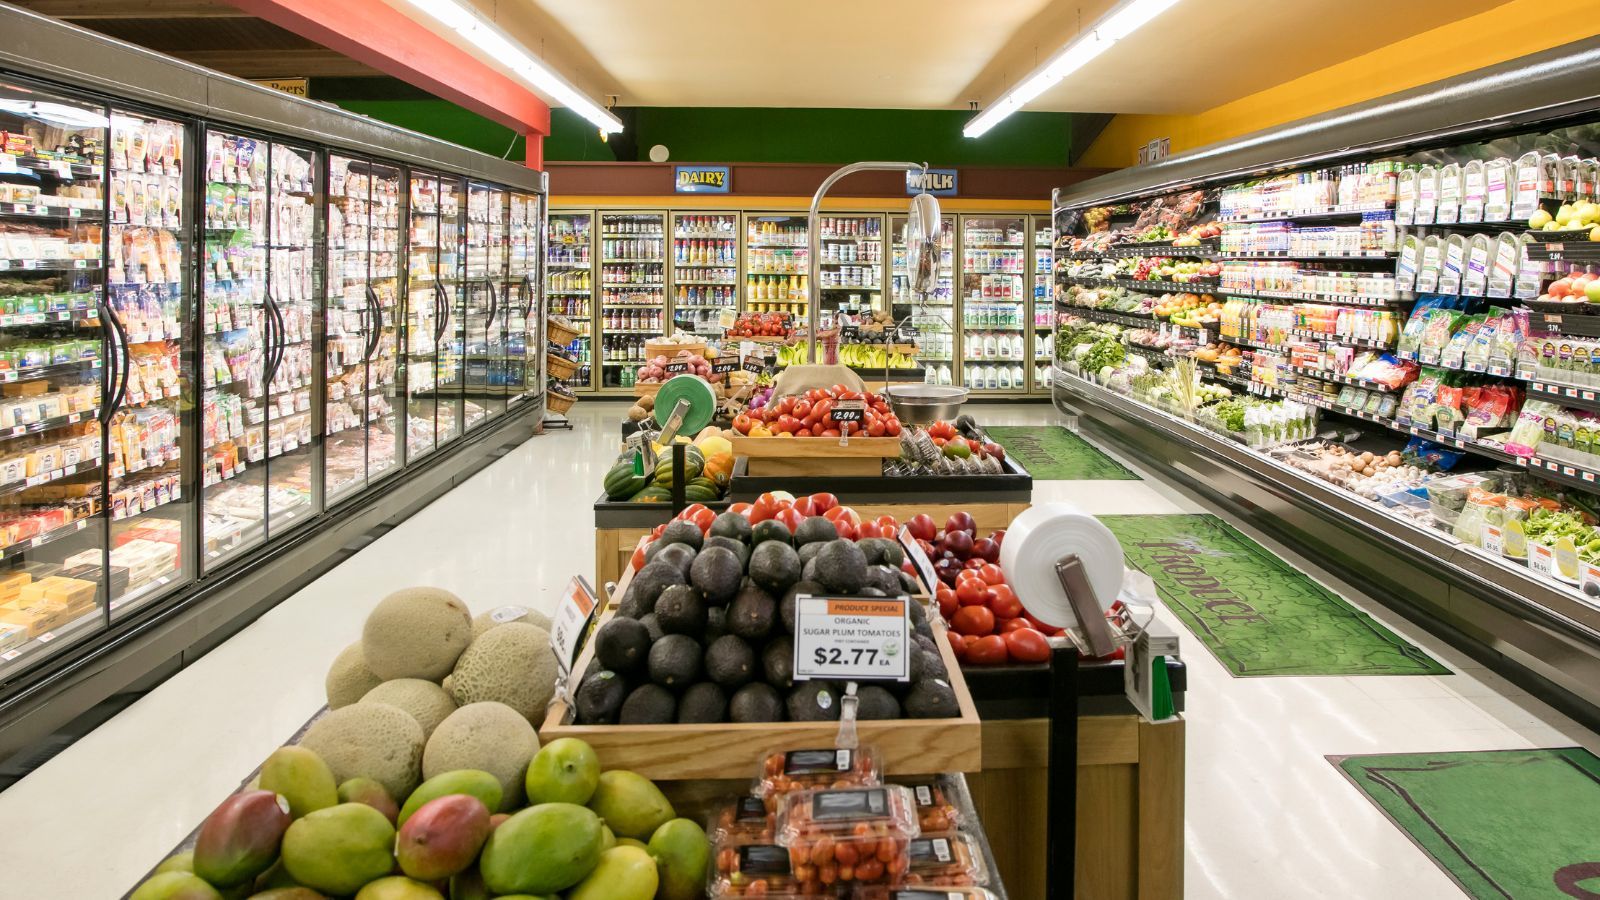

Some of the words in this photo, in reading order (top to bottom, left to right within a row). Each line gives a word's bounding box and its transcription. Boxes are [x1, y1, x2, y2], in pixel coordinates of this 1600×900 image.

[679, 171, 725, 187] DAIRY
[910, 172, 954, 190] MILK
[1136, 542, 1273, 626] PRODUCE
[834, 604, 869, 612] PRODUCE
[871, 605, 899, 613] SPECIAL
[834, 617, 871, 625] ORGANIC
[803, 628, 830, 636] SUGAR
[832, 628, 855, 637] PLUM
[857, 629, 901, 638] TOMATOES
[814, 647, 879, 666] $2.77
